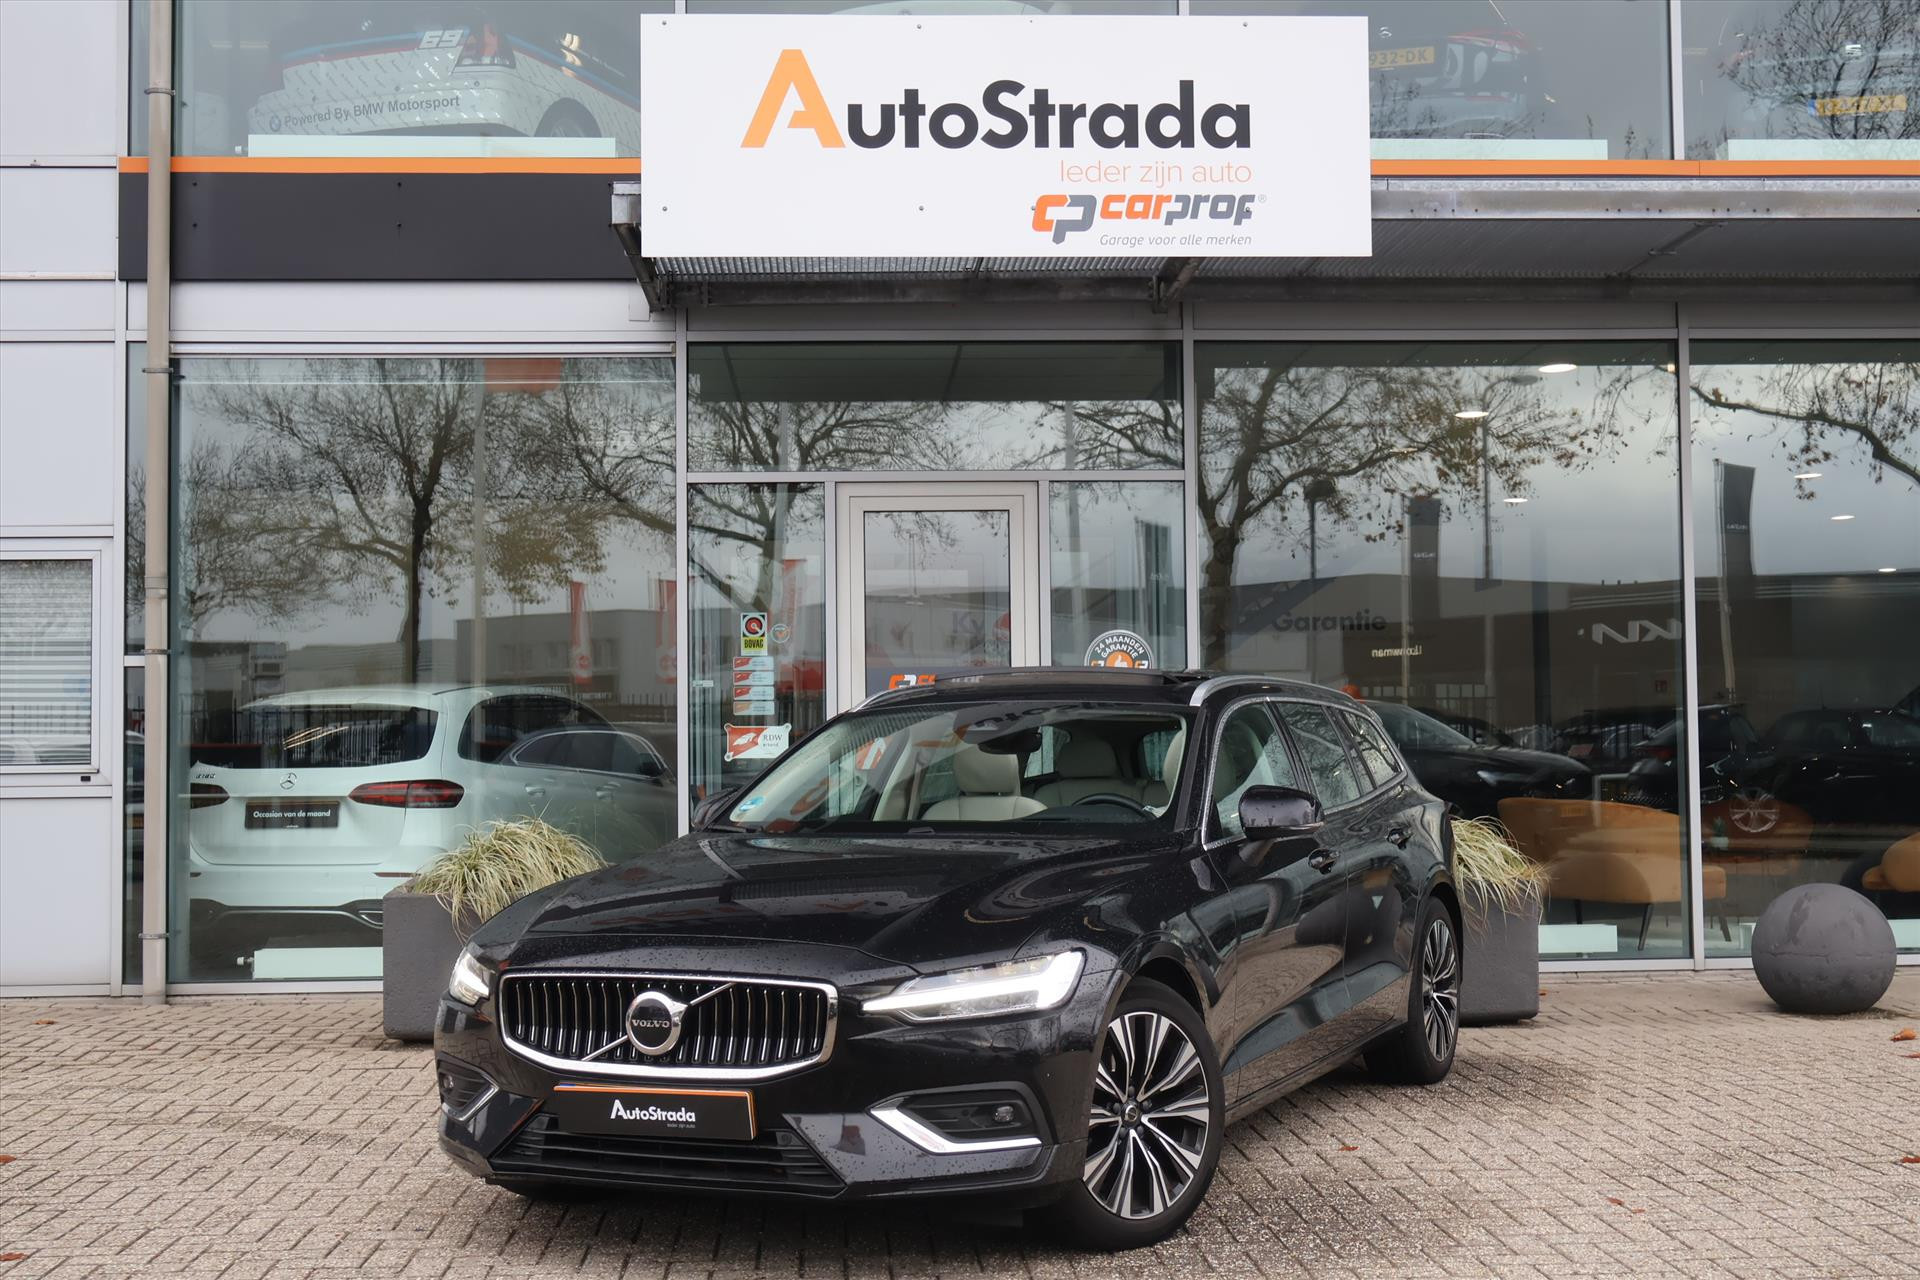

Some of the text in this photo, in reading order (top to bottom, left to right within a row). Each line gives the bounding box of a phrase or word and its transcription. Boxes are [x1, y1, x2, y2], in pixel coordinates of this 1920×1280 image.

[418, 29, 465, 49] 69
[740, 48, 1252, 149] AutoStrada
[284, 95, 461, 127] Powered By BMW Motorsport
[1060, 160, 1252, 188] Ieder zijn auto
[1100, 234, 1252, 248] Garage voor alle merken
[1272, 608, 1387, 632] Garantie
[1094, 635, 1145, 654] 24 MAANDEN
[1101, 643, 1139, 659] GARANTIE
[253, 810, 283, 818] Occasion
[297, 809, 307, 818] de
[307, 809, 331, 818] maand
[632, 1019, 670, 1028] VOLVO
[610, 1099, 696, 1122] AutoStrada
